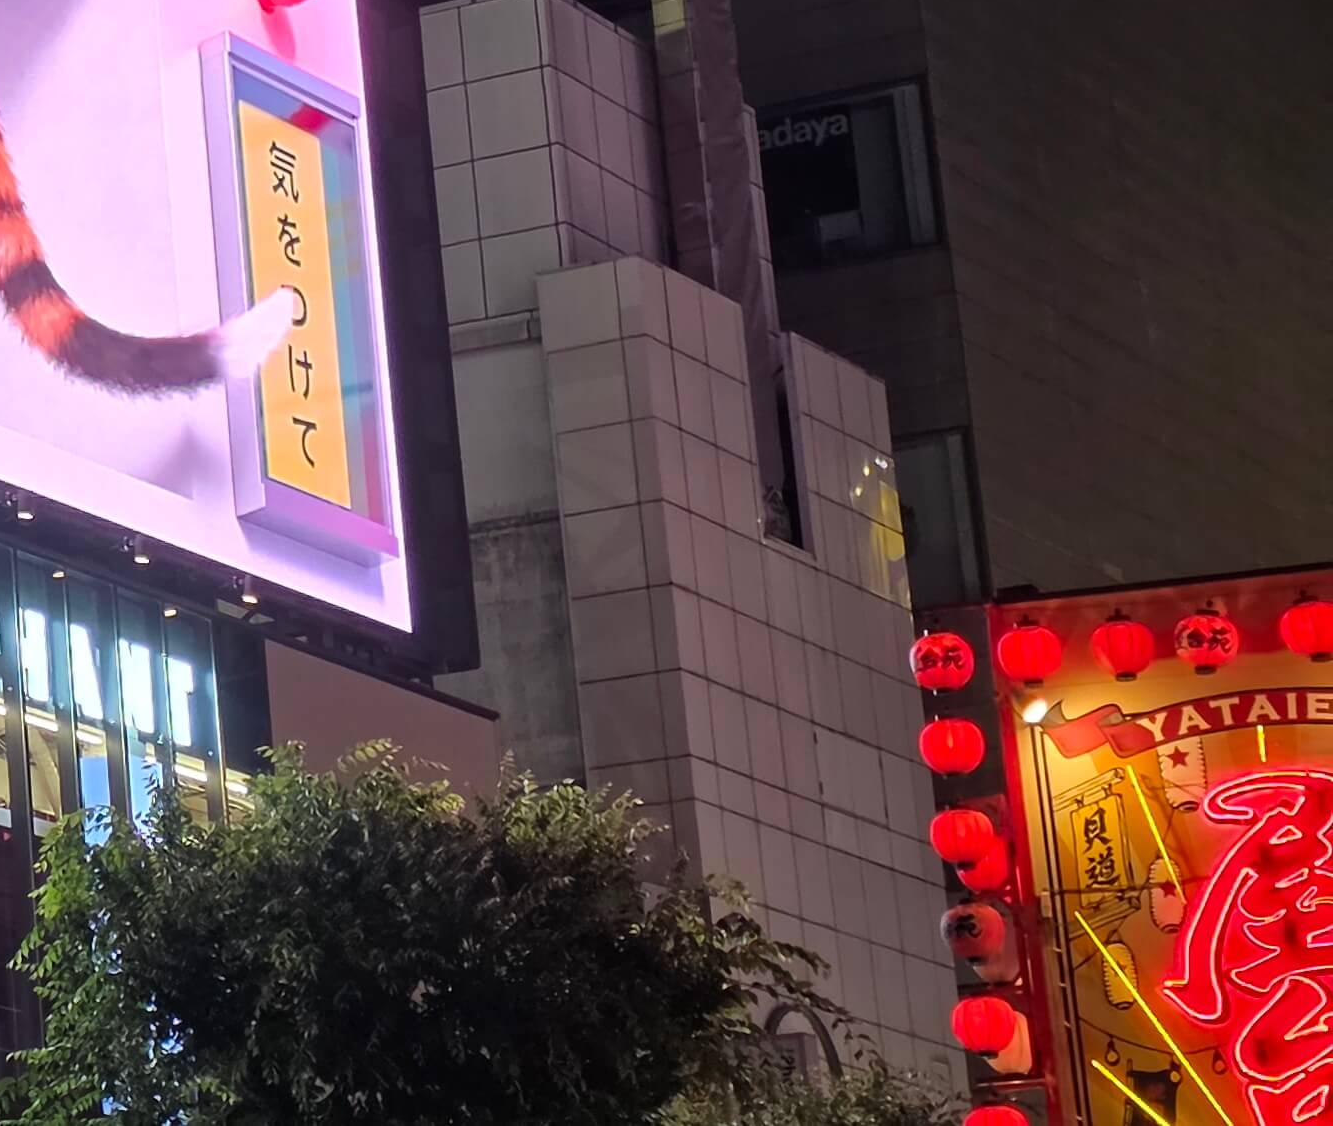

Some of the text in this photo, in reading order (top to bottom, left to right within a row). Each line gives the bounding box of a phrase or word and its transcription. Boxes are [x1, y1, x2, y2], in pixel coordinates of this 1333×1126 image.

[759, 113, 850, 151] adaya
[268, 139, 318, 469] 気をつけて
